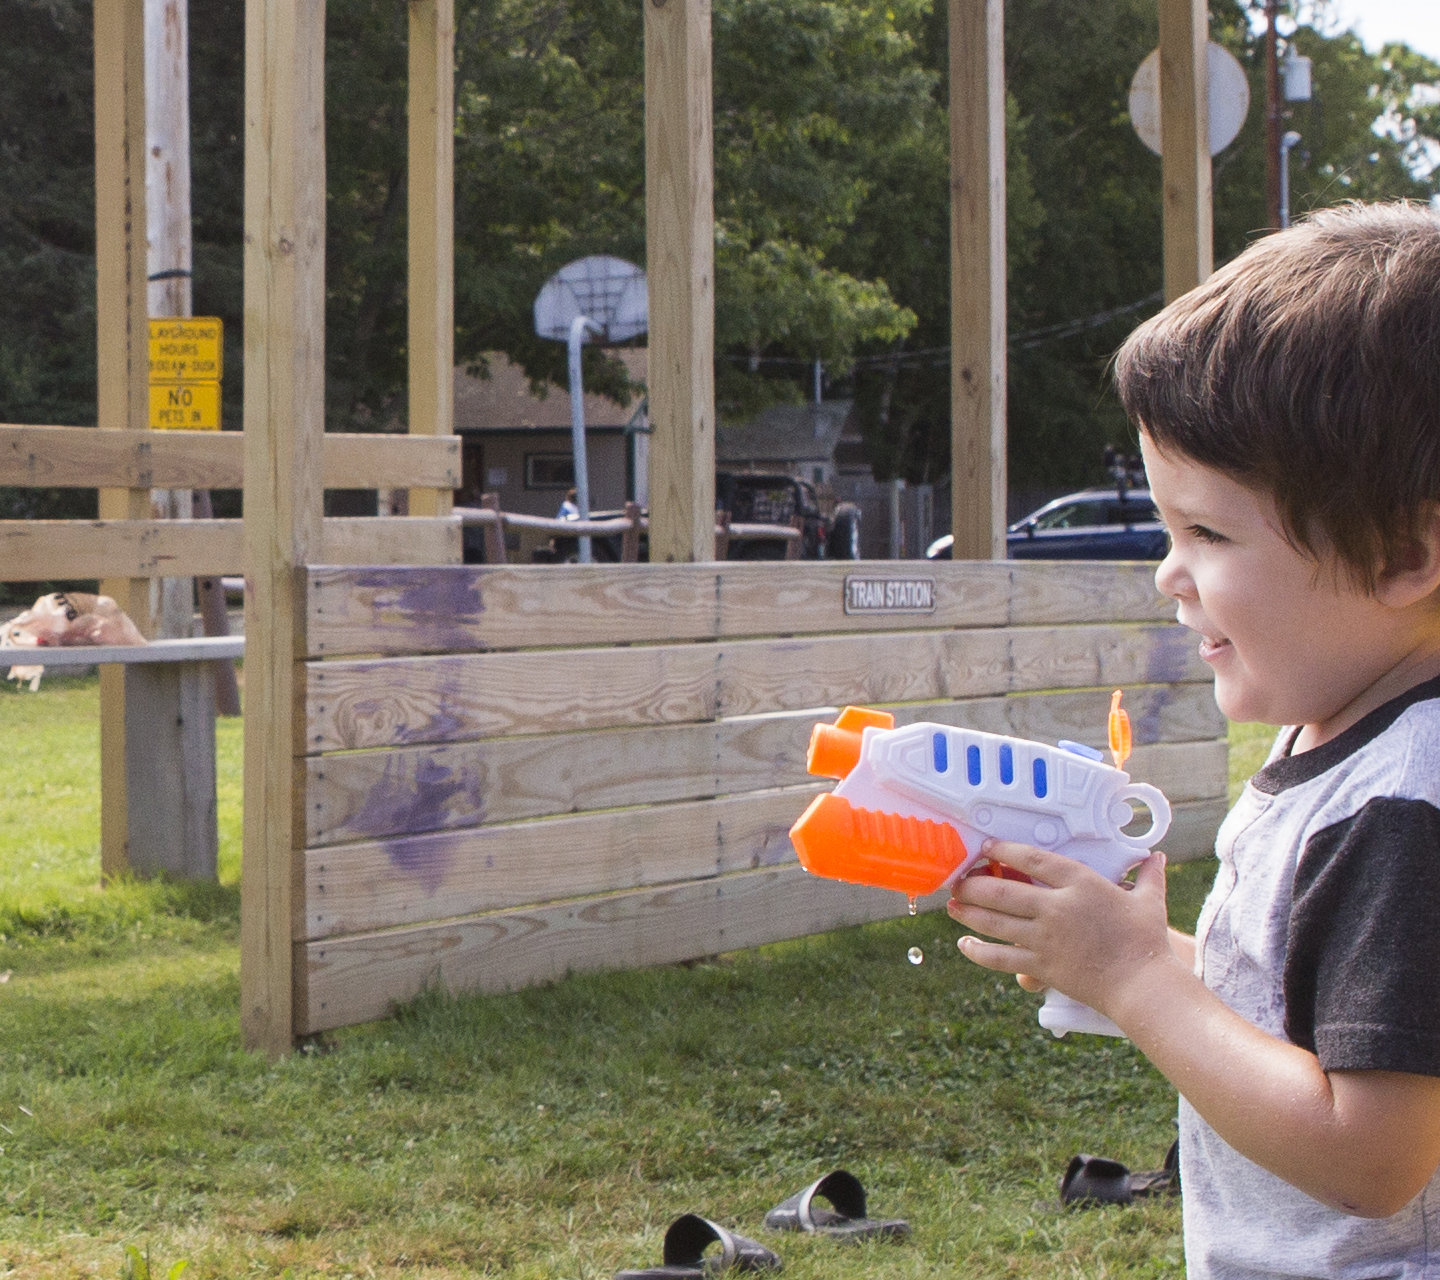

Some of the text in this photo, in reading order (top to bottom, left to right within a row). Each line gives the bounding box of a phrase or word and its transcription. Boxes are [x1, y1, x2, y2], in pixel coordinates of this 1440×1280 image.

[169, 389, 193, 406] NO
[851, 581, 932, 608] TRAIN STATION
